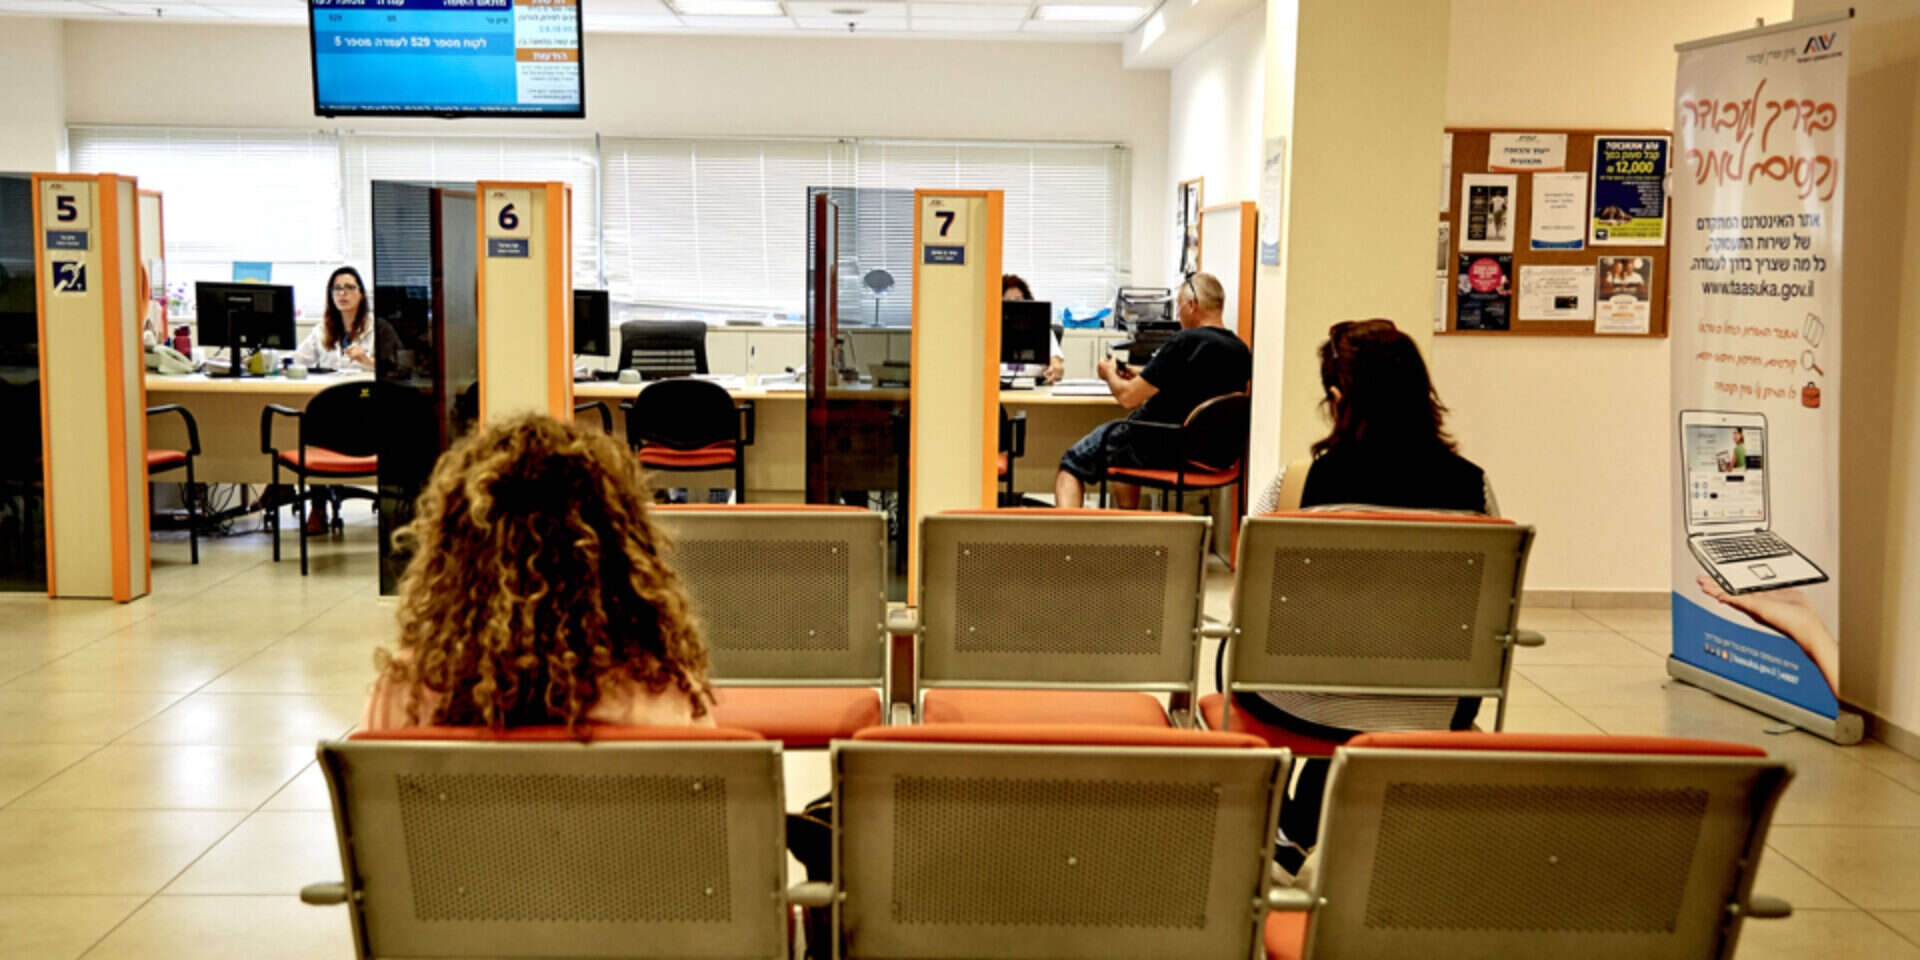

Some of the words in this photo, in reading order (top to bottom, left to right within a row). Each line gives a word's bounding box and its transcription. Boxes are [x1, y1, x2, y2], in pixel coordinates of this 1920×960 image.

[334, 35, 342, 47] 5
[344, 37, 372, 47] מספר
[375, 36, 408, 47] לעמדה
[411, 36, 431, 48] 529
[434, 38, 461, 49] מספר
[463, 37, 487, 50] לקוח
[1681, 77, 1767, 142] לעבודה
[1762, 97, 1838, 152] בדרך
[1687, 132, 1752, 186] לאתר
[57, 195, 77, 222] 5
[498, 202, 519, 230] 6
[935, 211, 955, 237] 7
[1741, 214, 1795, 229] האינטרנט
[1797, 214, 1820, 228] אתר
[1757, 236, 1790, 250] שירות
[1793, 232, 1811, 250] של
[1754, 257, 1790, 275] שצריך
[1793, 257, 1810, 272] מה
[1813, 254, 1827, 272] כל
[1702, 279, 1815, 301] www.taasuka.gov.il
